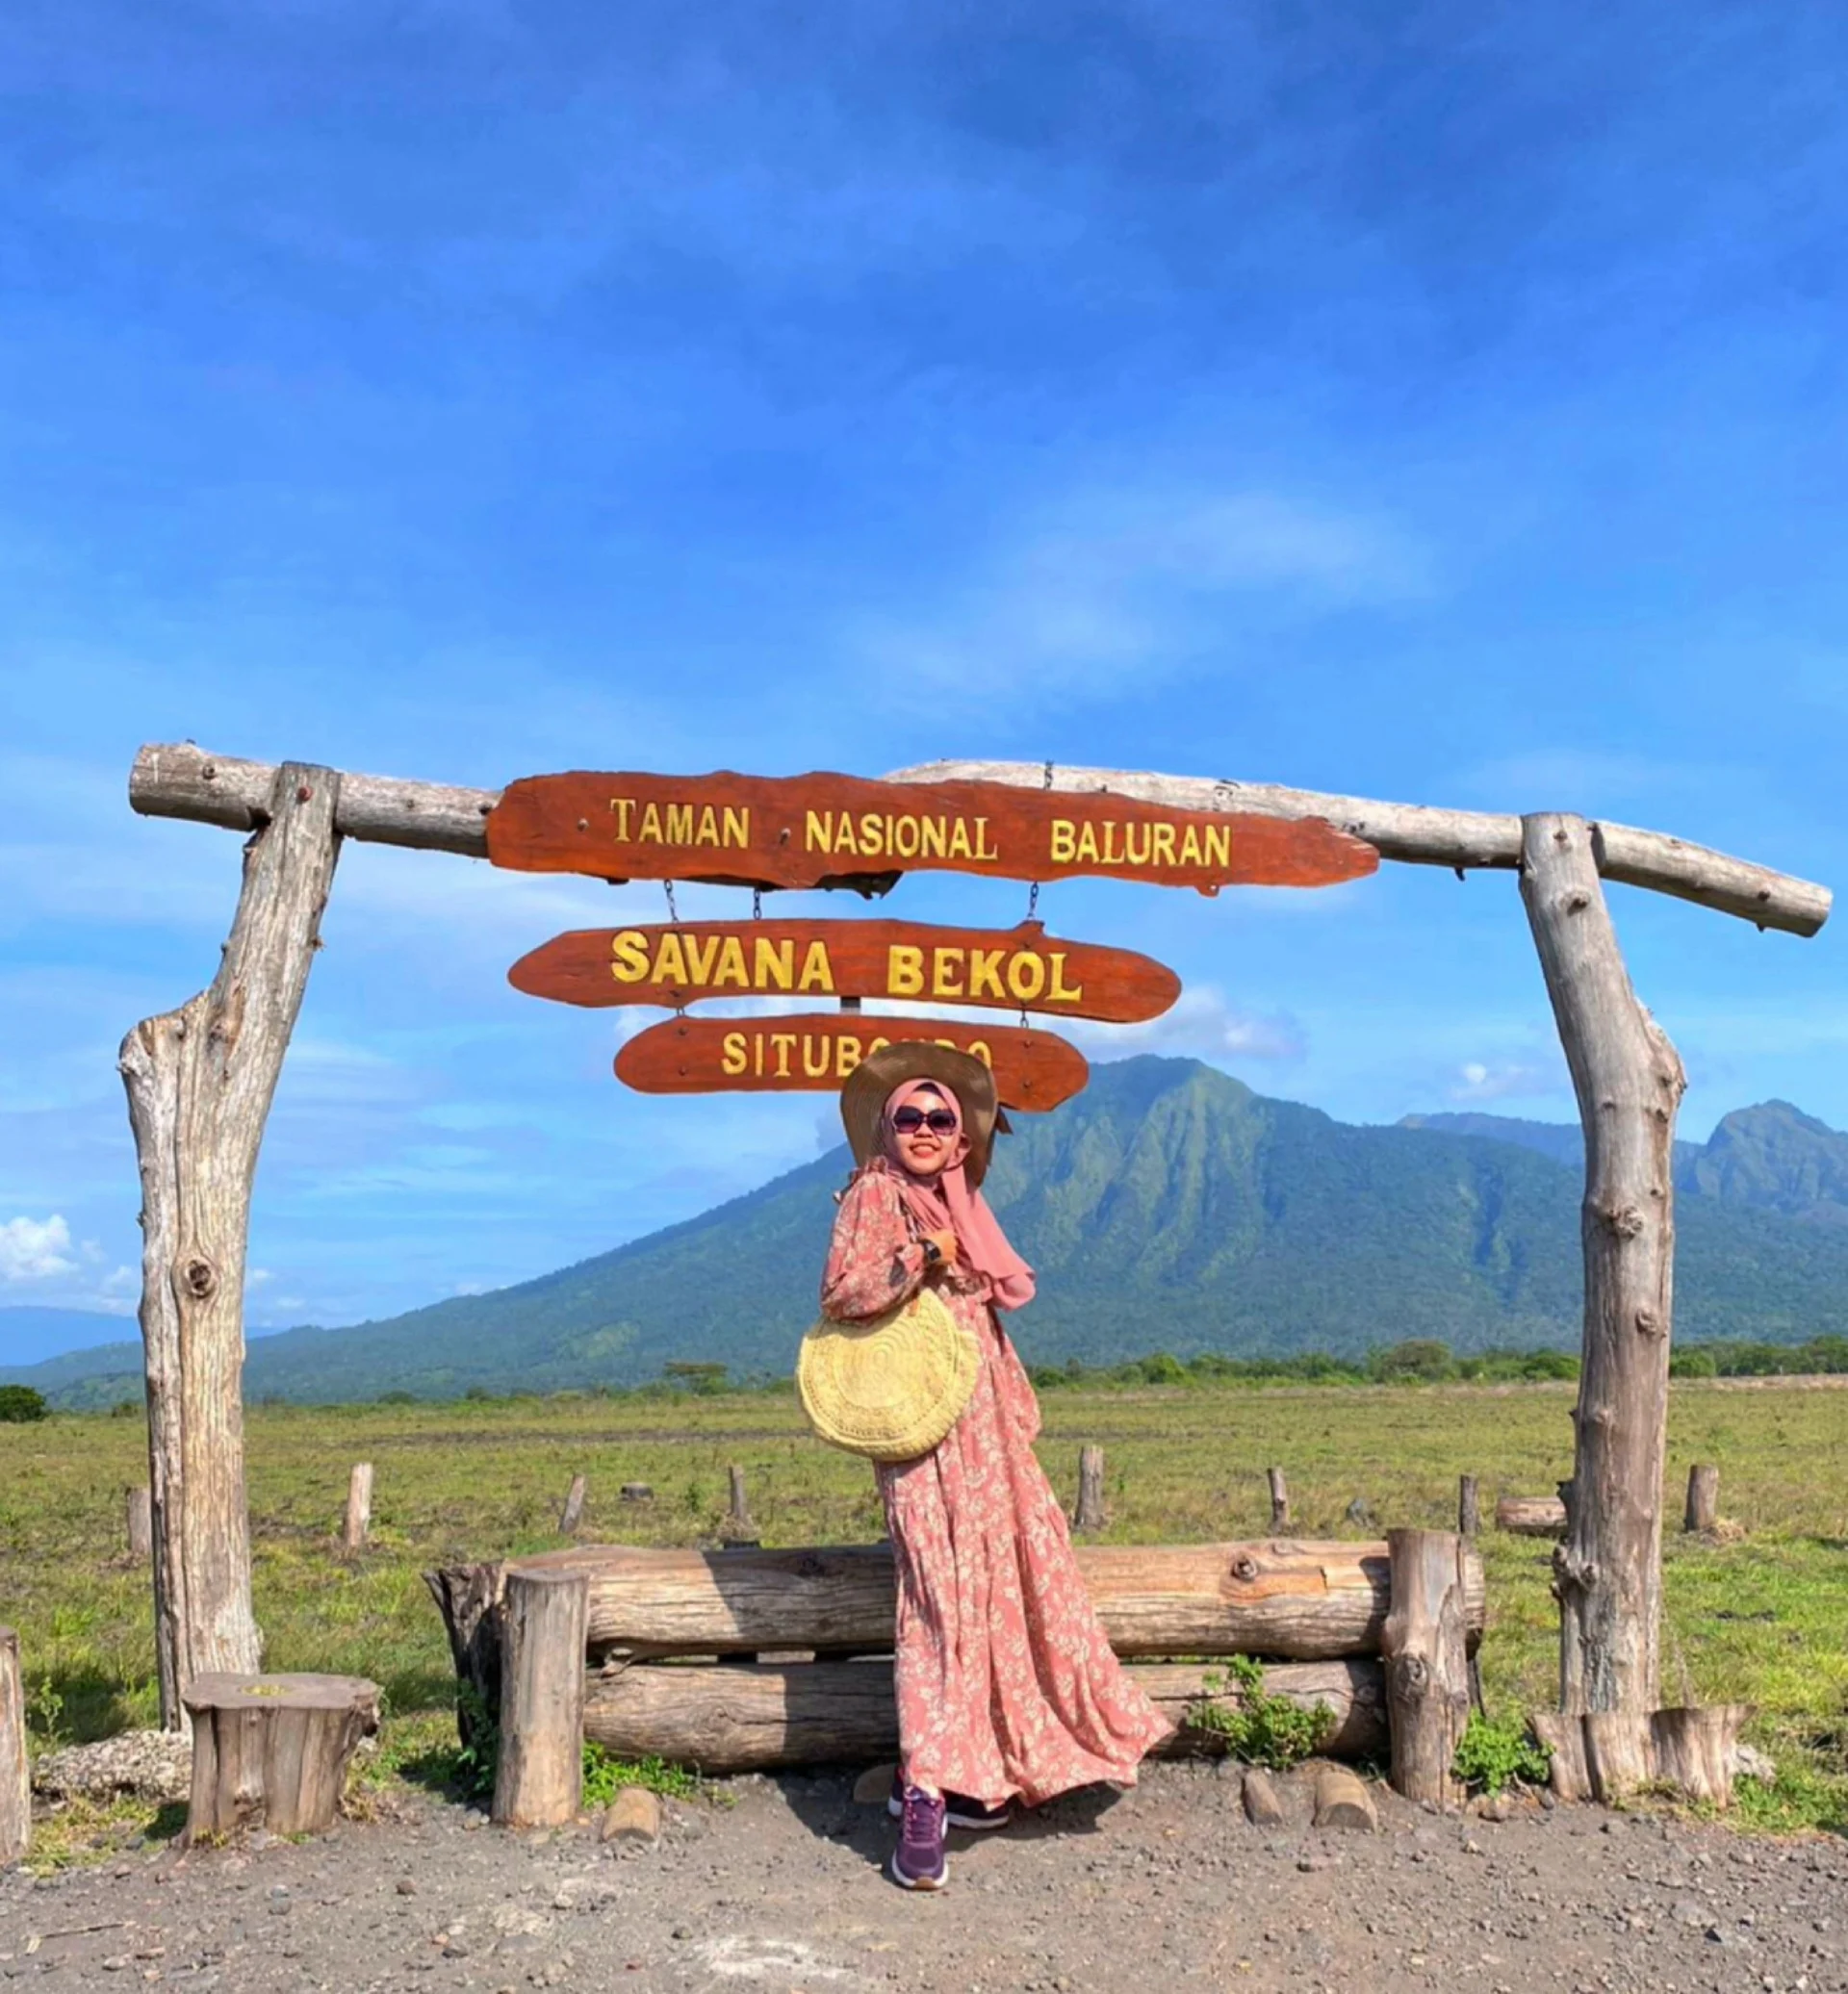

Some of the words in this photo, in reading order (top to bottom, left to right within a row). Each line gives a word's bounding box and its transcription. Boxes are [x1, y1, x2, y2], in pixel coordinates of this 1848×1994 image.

[610, 799, 750, 848] TAMAN
[806, 811, 997, 860] NASIONAL
[1050, 819, 1232, 868] BALURAN
[611, 931, 834, 992] SAVANA
[886, 945, 1083, 1003] BEKOL
[722, 1034, 992, 1078] SITUBO
